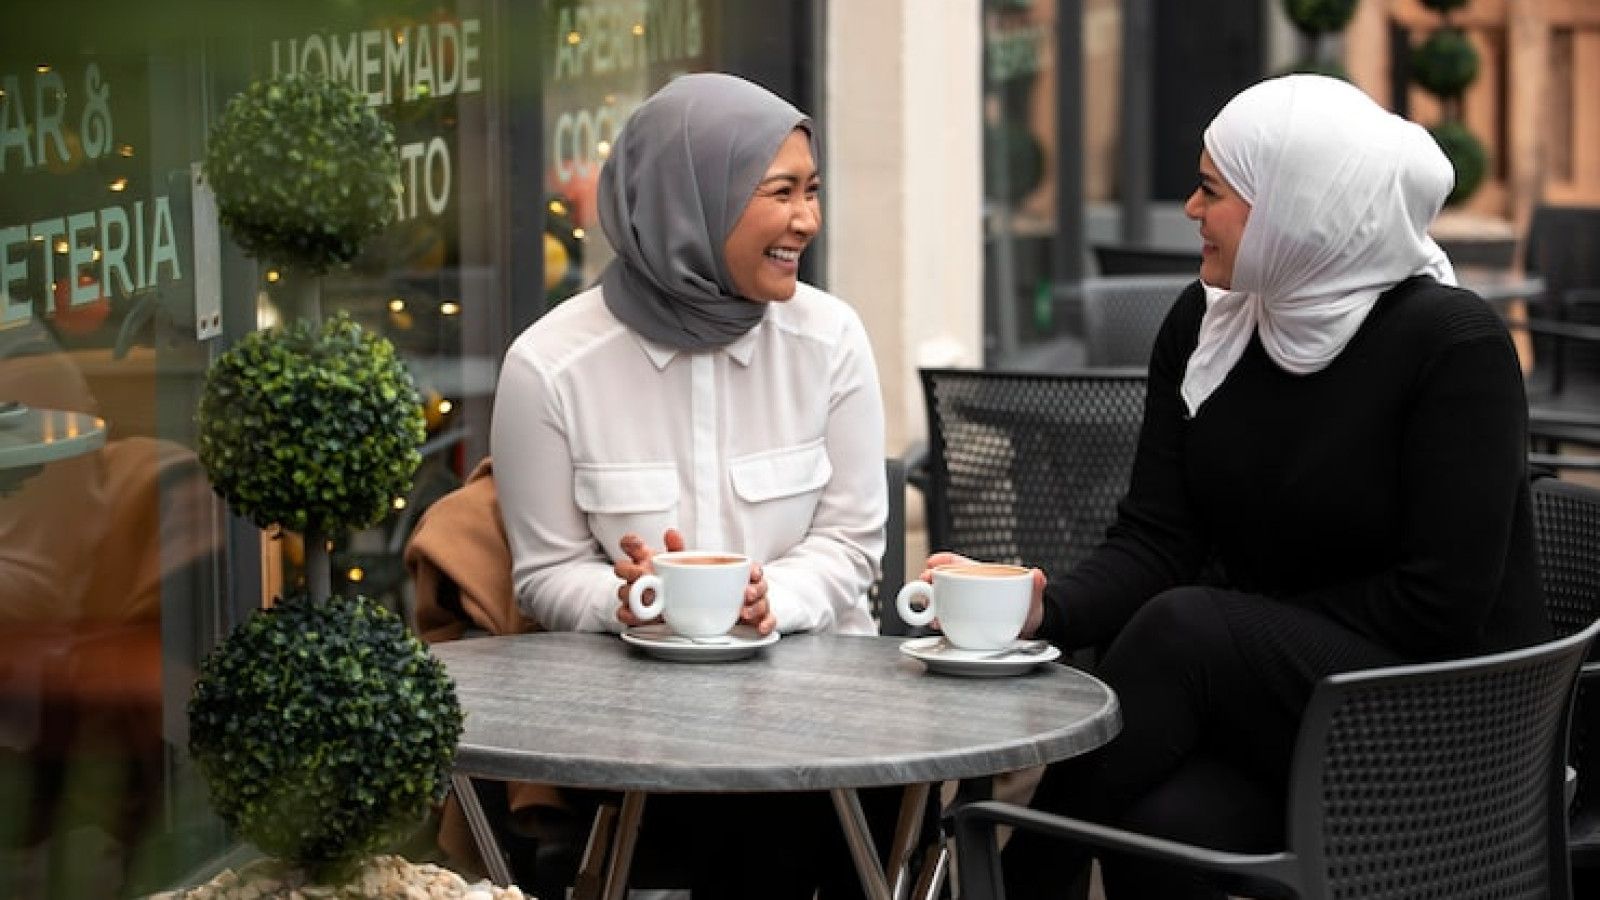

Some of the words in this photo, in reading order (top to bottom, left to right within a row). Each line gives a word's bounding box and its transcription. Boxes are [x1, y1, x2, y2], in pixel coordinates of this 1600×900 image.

[269, 18, 482, 107] HOMEMADE
[0, 71, 72, 173] AR
[81, 62, 114, 160] &
[397, 135, 451, 221] TO
[0, 195, 183, 323] ETERIA
